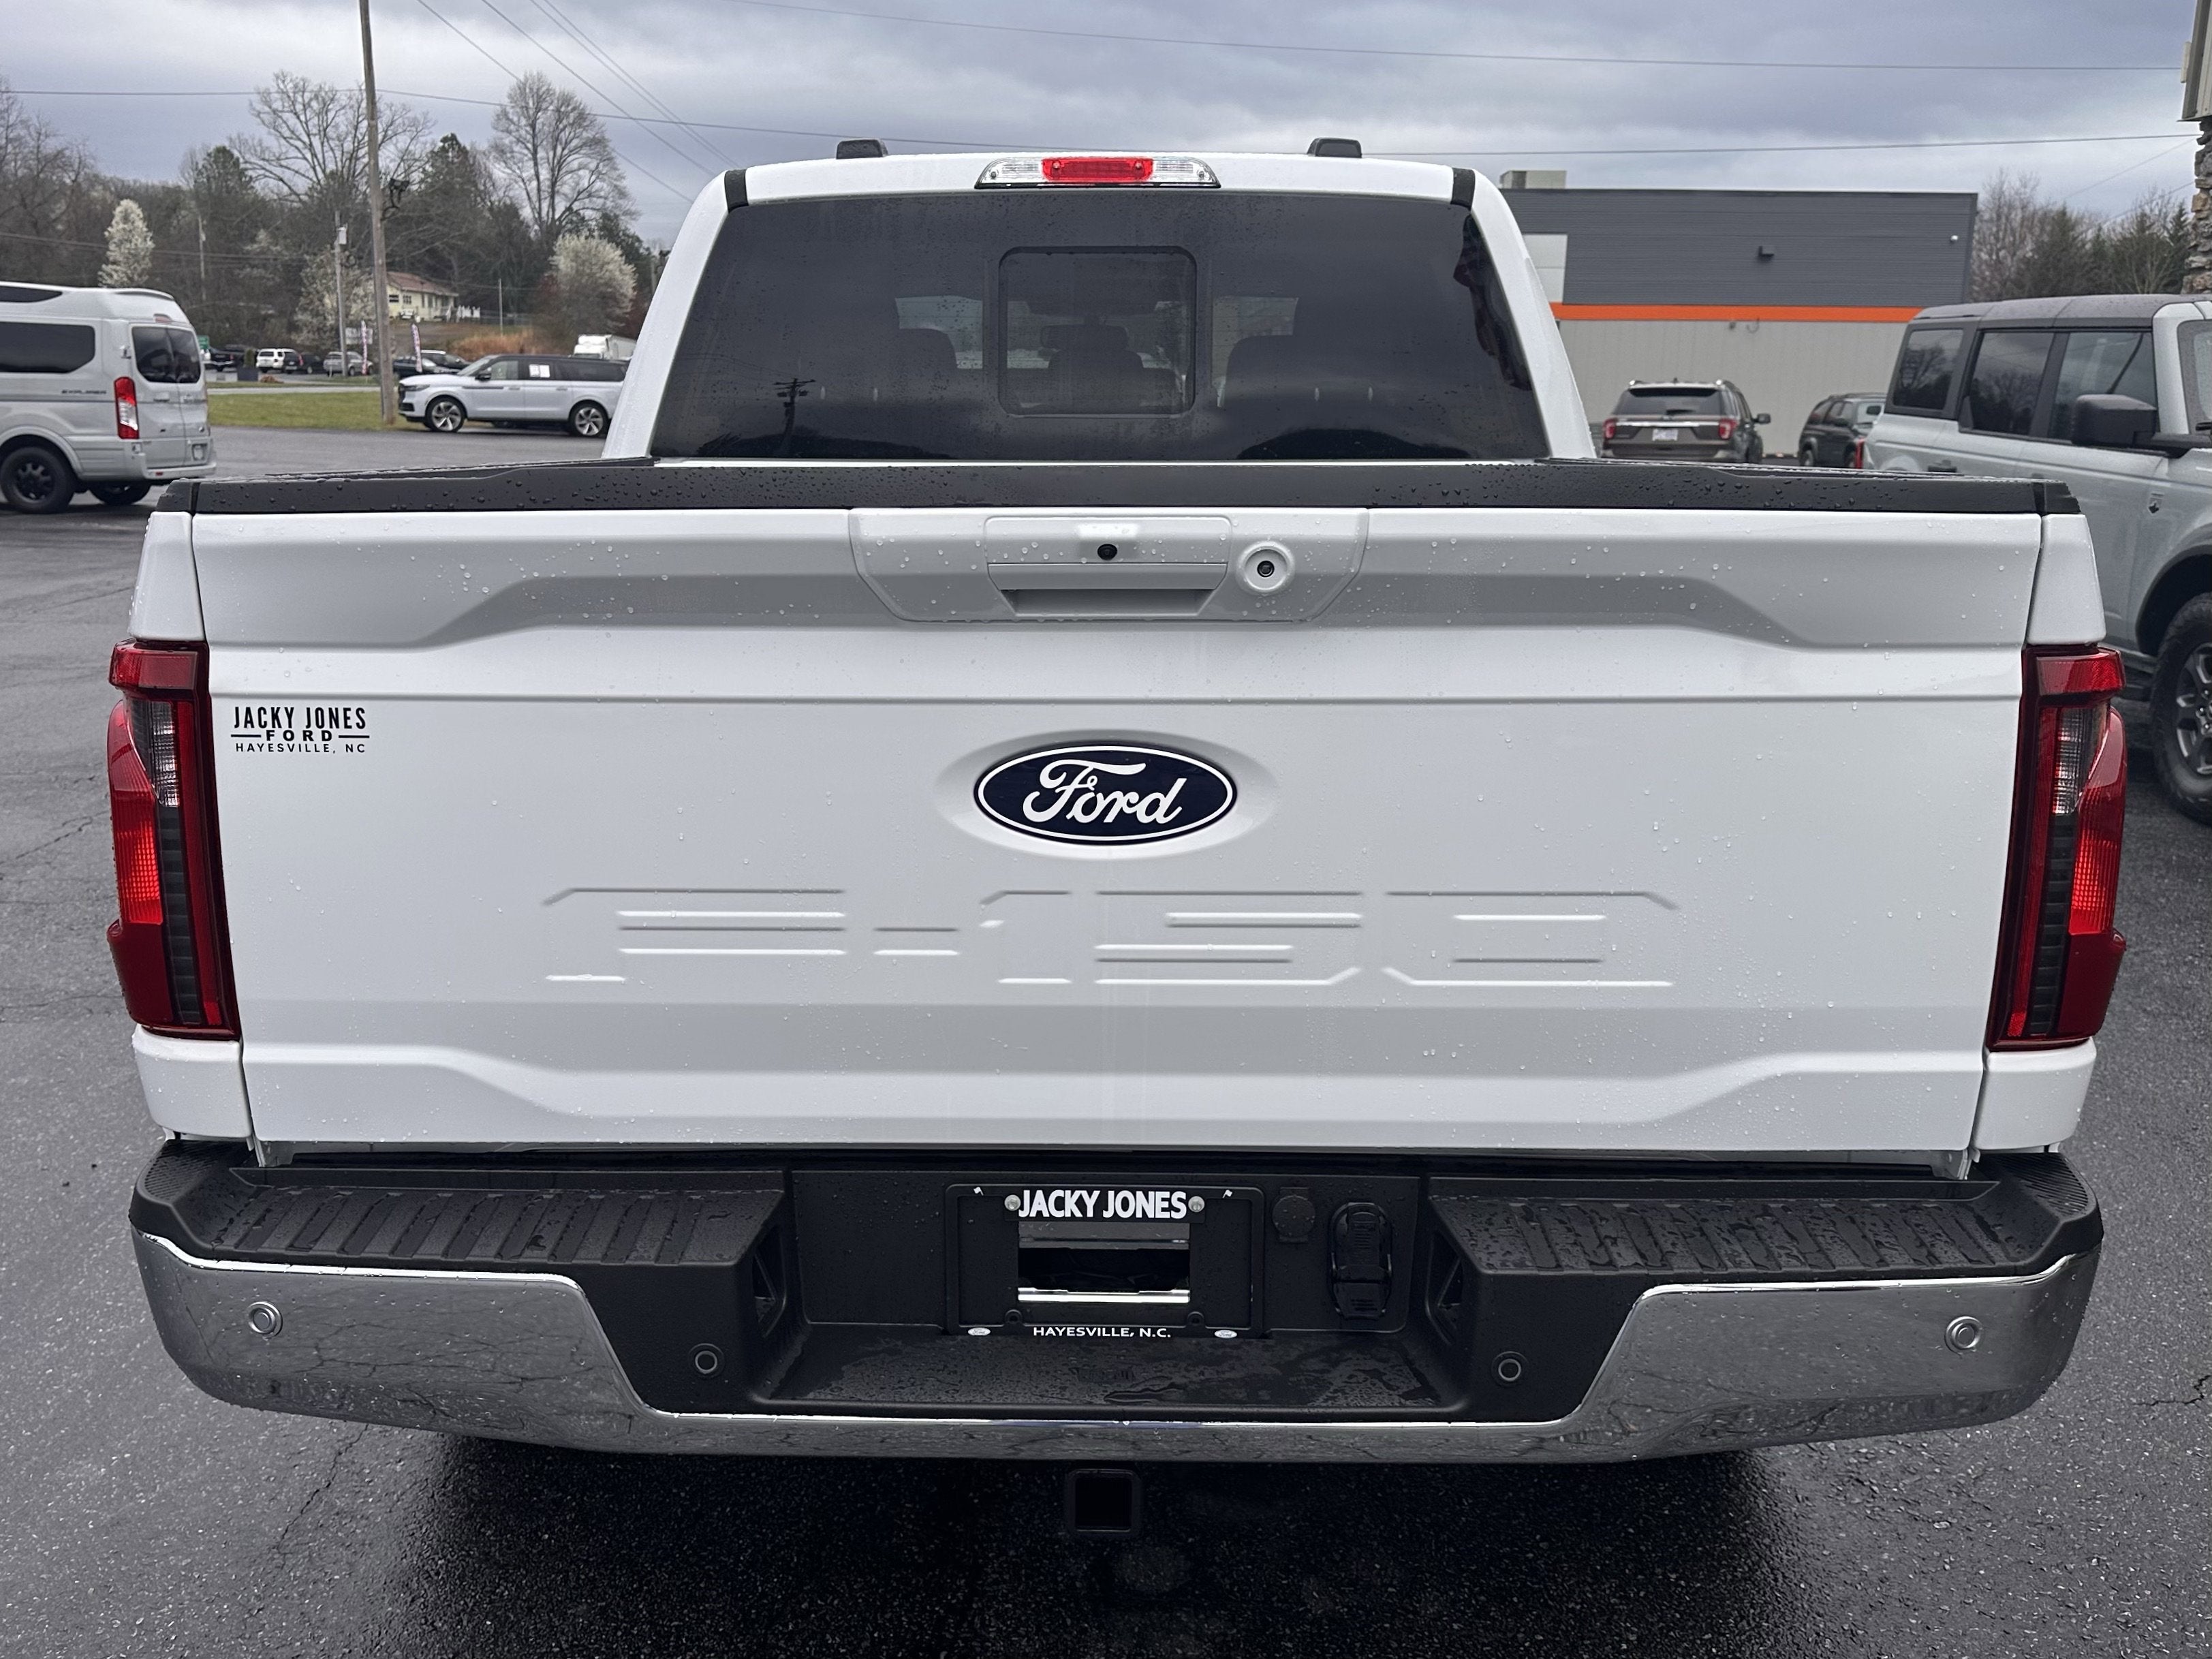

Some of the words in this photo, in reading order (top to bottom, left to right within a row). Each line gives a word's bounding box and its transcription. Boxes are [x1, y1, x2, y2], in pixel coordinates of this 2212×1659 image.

[234, 706, 295, 729] JACKY
[305, 707, 367, 730] JONES
[266, 730, 332, 742] FORD
[236, 743, 336, 754] HAYESVILLE,
[345, 743, 365, 753] NC
[1023, 759, 1187, 824] Ford
[1018, 1189, 1101, 1218] JACKY
[1102, 1190, 1187, 1220] JONES
[1033, 1327, 1135, 1337] HAYESVILLE,
[1139, 1328, 1171, 1338] N.C.
